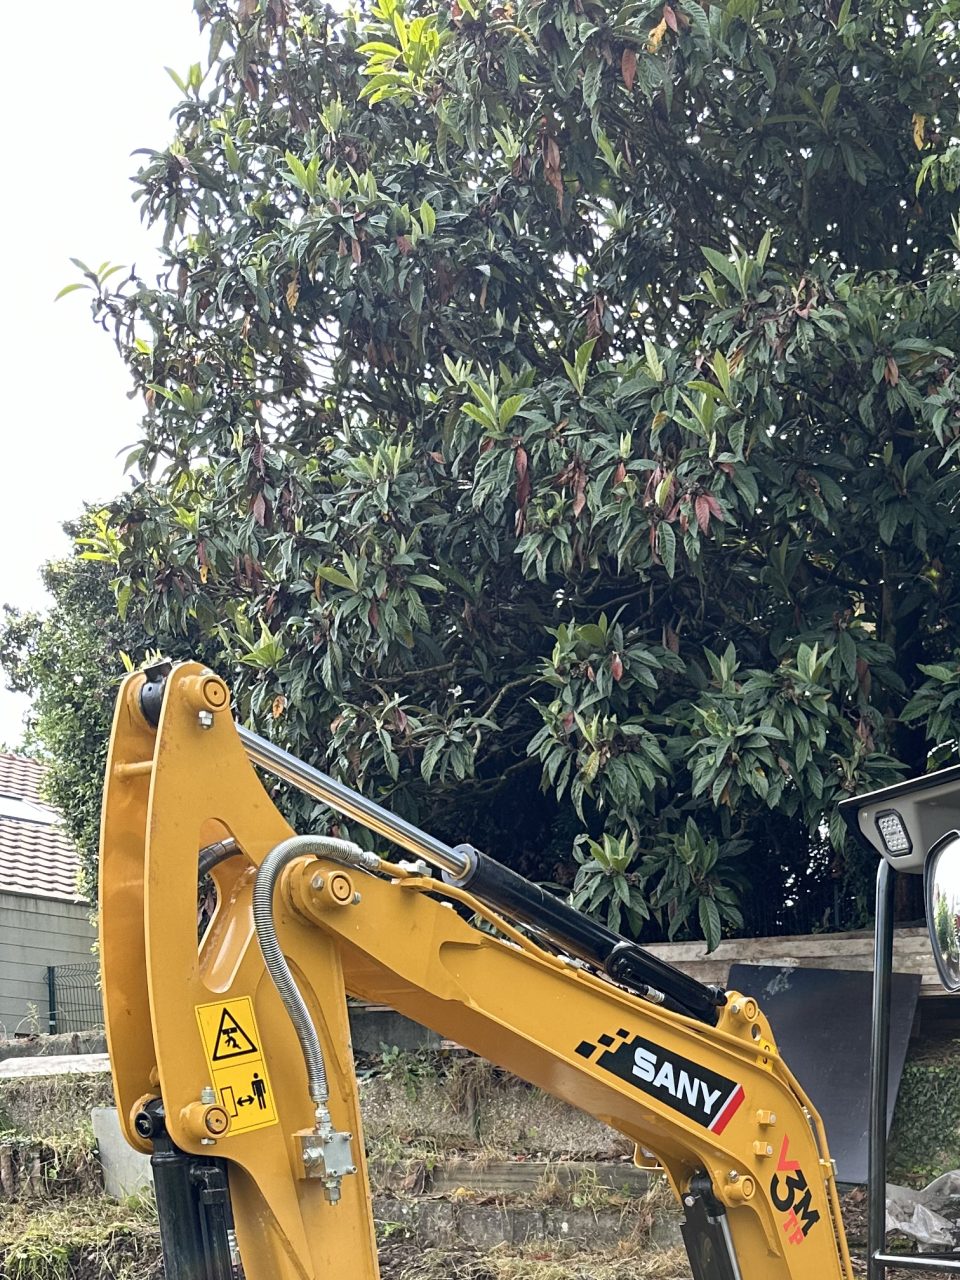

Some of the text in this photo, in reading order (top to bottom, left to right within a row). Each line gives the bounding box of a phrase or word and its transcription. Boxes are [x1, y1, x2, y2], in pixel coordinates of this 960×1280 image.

[632, 1047, 722, 1115] SANY
[770, 1132, 820, 1237] V3M
[783, 1208, 805, 1246] TP
